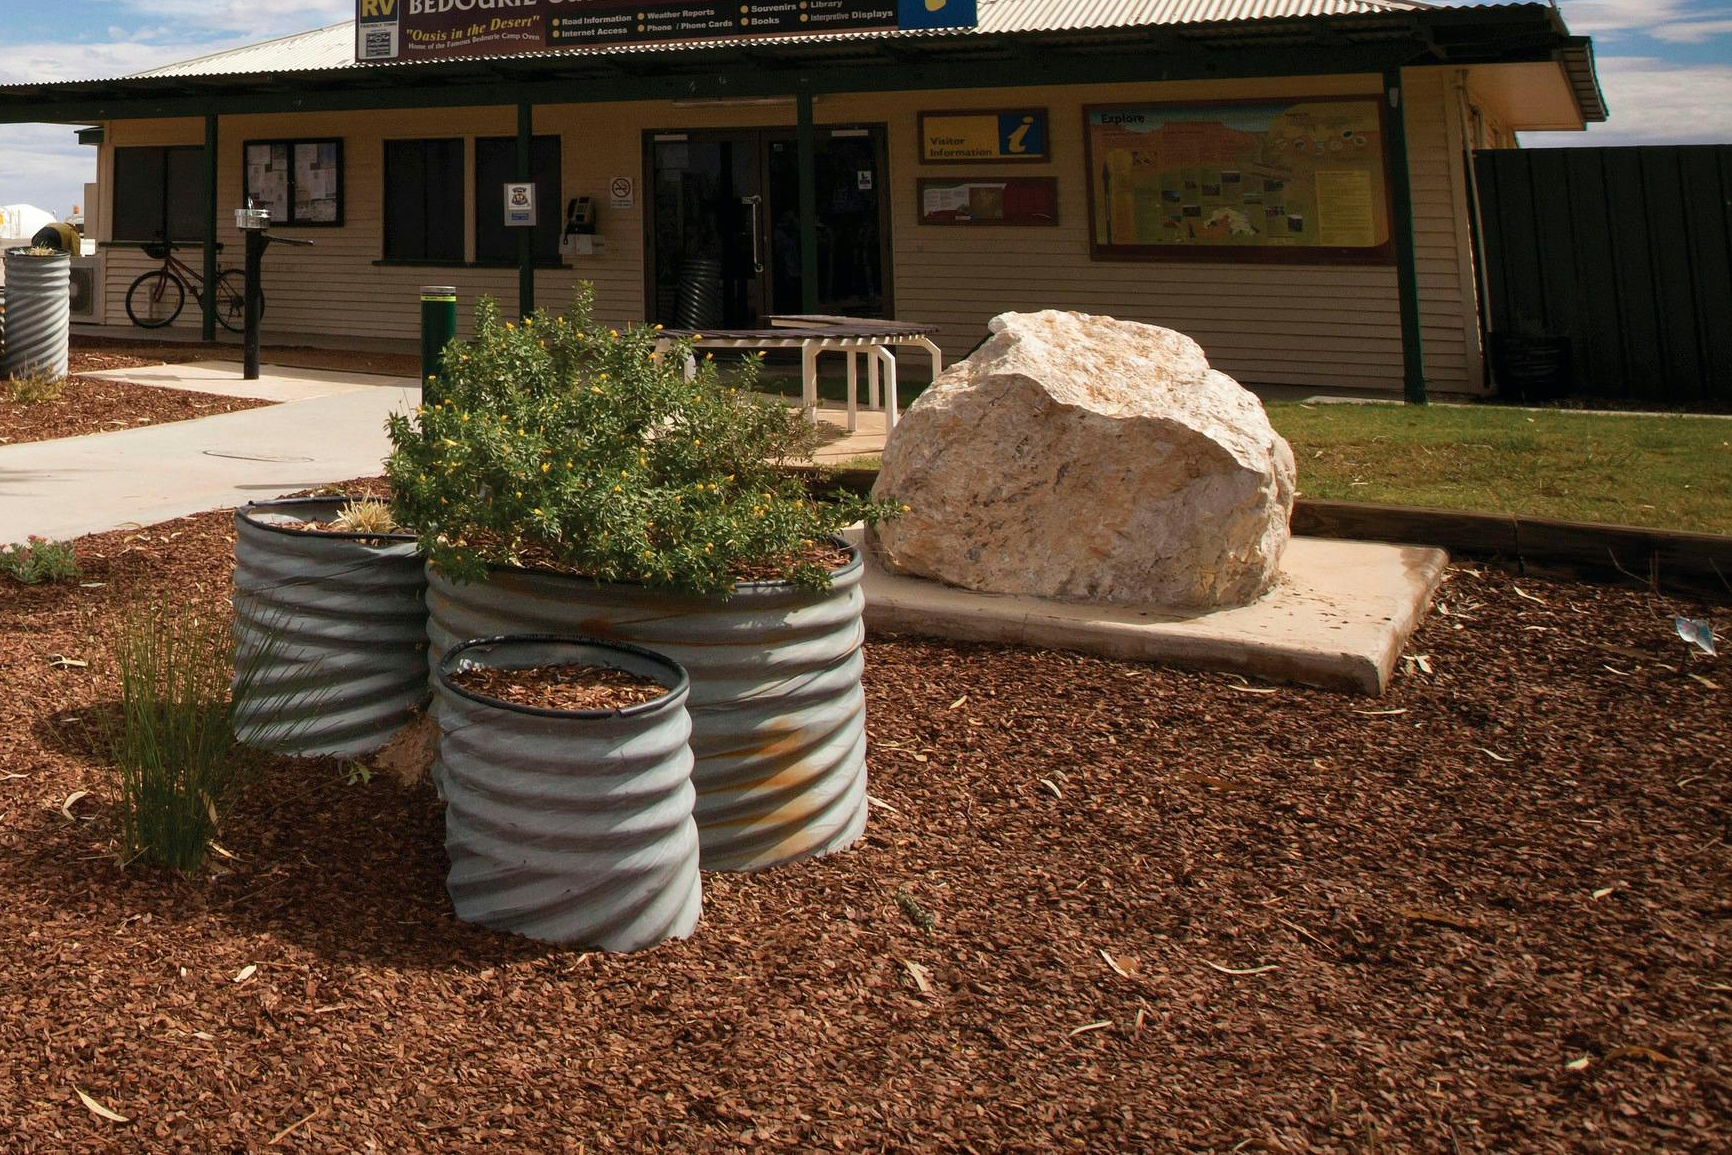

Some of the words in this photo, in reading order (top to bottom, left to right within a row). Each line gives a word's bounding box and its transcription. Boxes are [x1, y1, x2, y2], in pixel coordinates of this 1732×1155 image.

[751, 3, 797, 13] Souvenirs
[810, 0, 843, 9] Library
[647, 11, 681, 19] Weather
[682, 9, 715, 18] Reports
[810, 12, 850, 22] Interpretive
[851, 9, 894, 20] Displays
[562, 17, 583, 26] Road
[584, 14, 632, 24] Information
[751, 17, 780, 25] Books
[406, 29, 447, 42] "Oasis
[451, 27, 463, 39] in
[468, 23, 485, 36] the
[490, 15, 540, 31] Desert"
[647, 23, 672, 32] Phone
[681, 21, 706, 30] Phone
[709, 20, 733, 28] Cards
[562, 29, 595, 38] Internet
[597, 27, 628, 35] Access
[408, 42, 427, 50] Home
[436, 41, 445, 49] the
[447, 38, 470, 48] Famous
[472, 33, 500, 43] Bedourie
[501, 32, 520, 41] Camp
[522, 32, 540, 41] Oven
[1100, 113, 1145, 126] Explore
[930, 136, 966, 146] Visitor
[930, 148, 992, 157] Information
